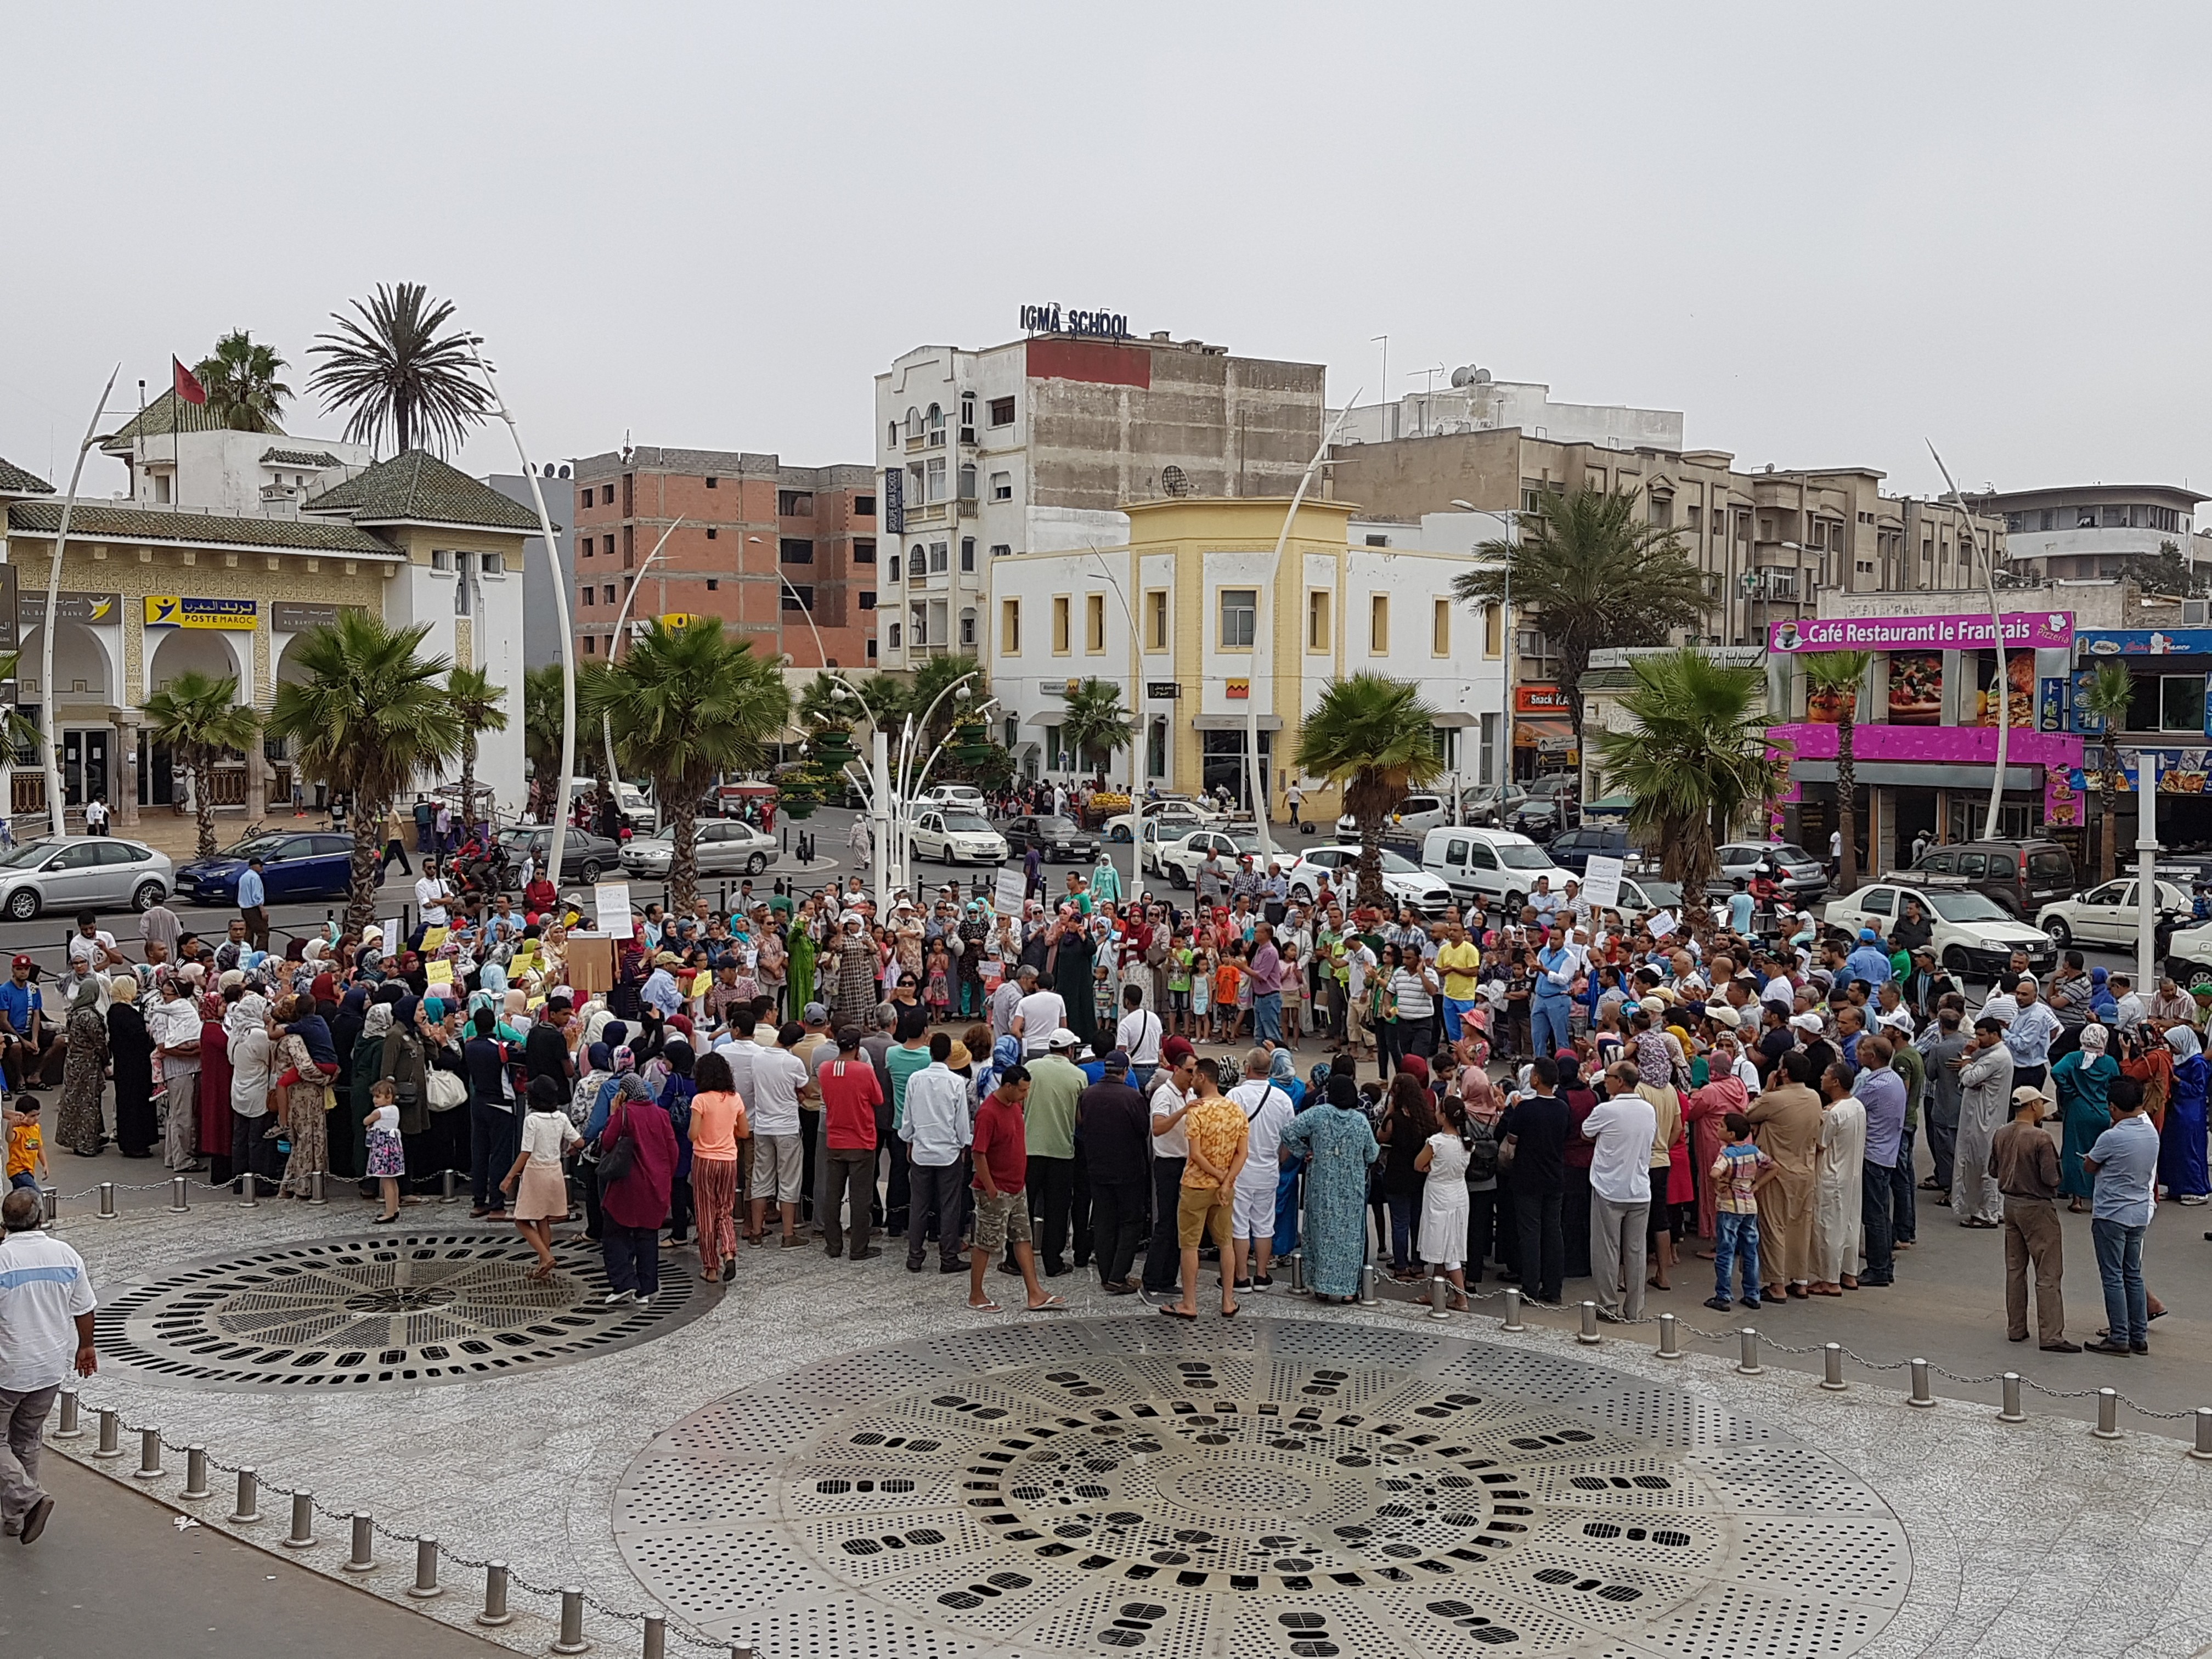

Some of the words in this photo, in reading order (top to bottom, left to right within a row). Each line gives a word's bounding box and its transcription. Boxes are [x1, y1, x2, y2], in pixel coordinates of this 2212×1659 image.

[1020, 304, 1060, 332] IGMA
[1068, 309, 1131, 339] SCHOOL
[888, 471, 897, 493] SCHOOL
[888, 494, 896, 507] IGMA
[888, 509, 897, 531] GROUPE
[184, 601, 218, 613] المغرب
[220, 603, 253, 614] بريد
[185, 615, 217, 623] POSTE
[1809, 623, 1843, 643] Café
[1847, 623, 1936, 642] Restaurant
[1939, 620, 1954, 641] le
[2036, 627, 2069, 644] Pizzeria
[1531, 693, 1553, 704] Snack
